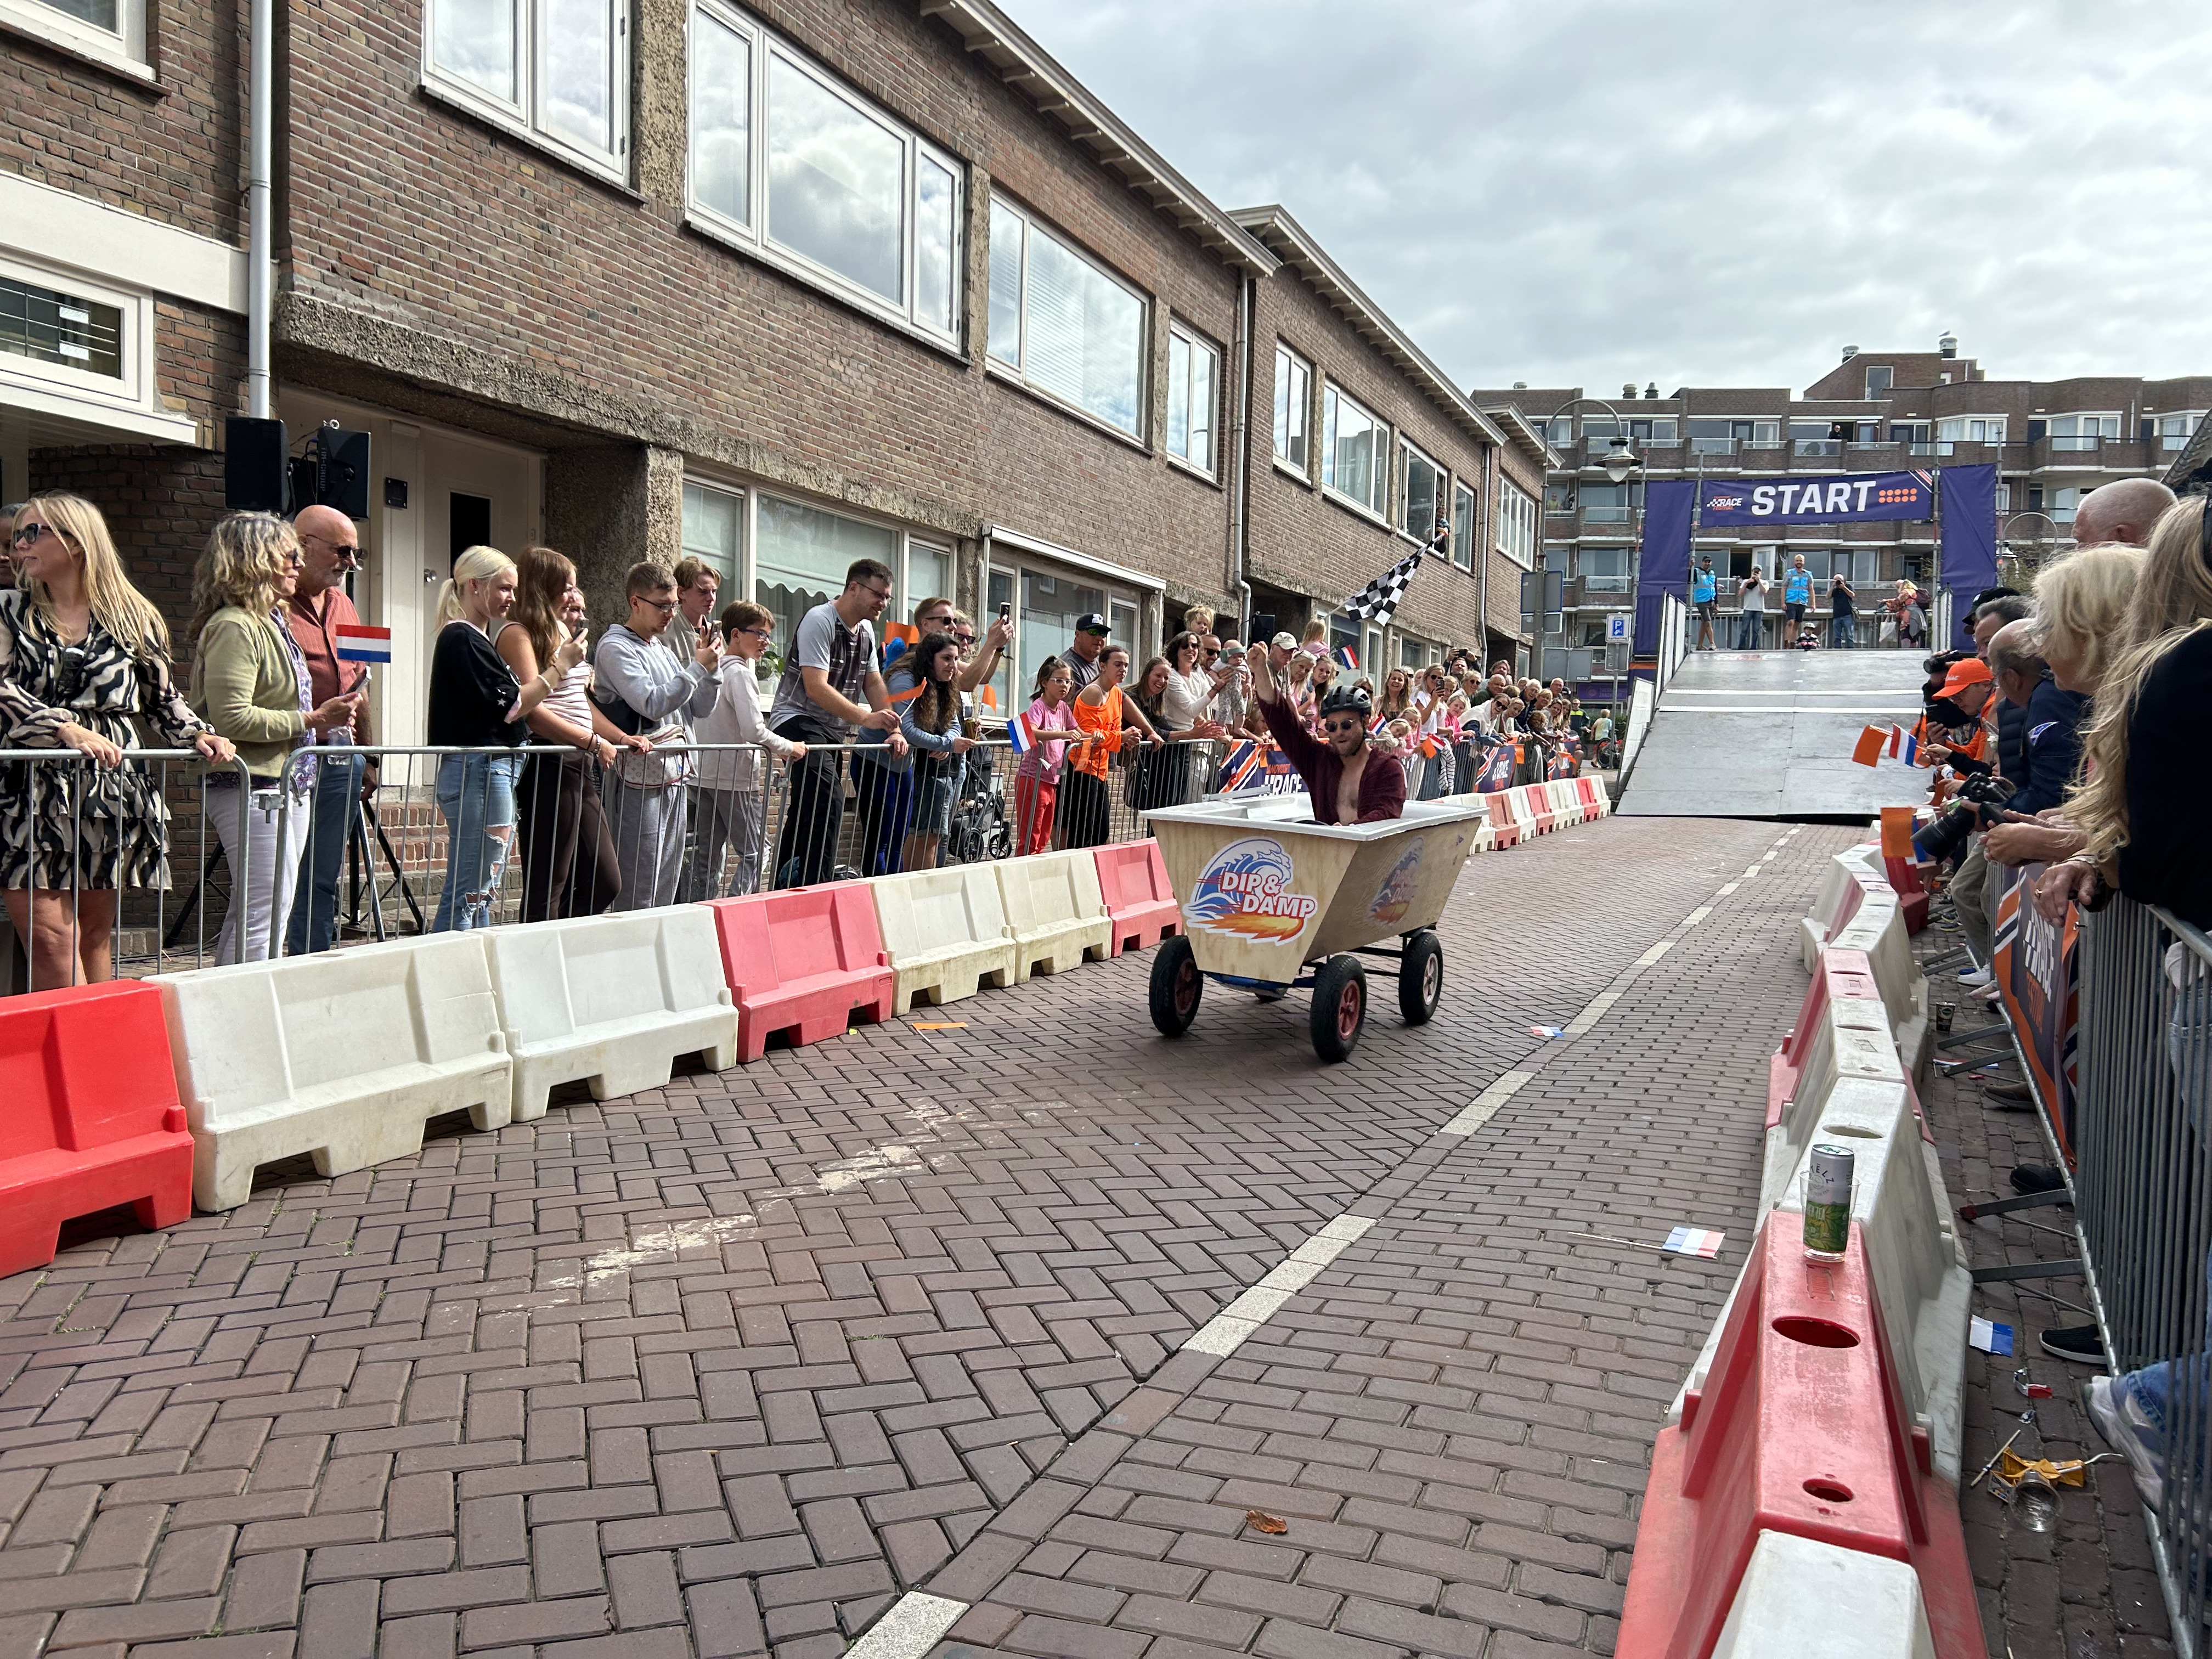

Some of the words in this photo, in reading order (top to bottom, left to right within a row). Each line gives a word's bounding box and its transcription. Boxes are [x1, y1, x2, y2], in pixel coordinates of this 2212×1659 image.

[1718, 498, 1743, 506] RACE
[1751, 481, 1876, 515] START
[1615, 620, 1622, 629] P
[1272, 773, 1302, 795] RACE
[1221, 871, 1262, 893] DIP
[1263, 874, 1282, 895] &
[1242, 894, 1315, 918] DAMP
